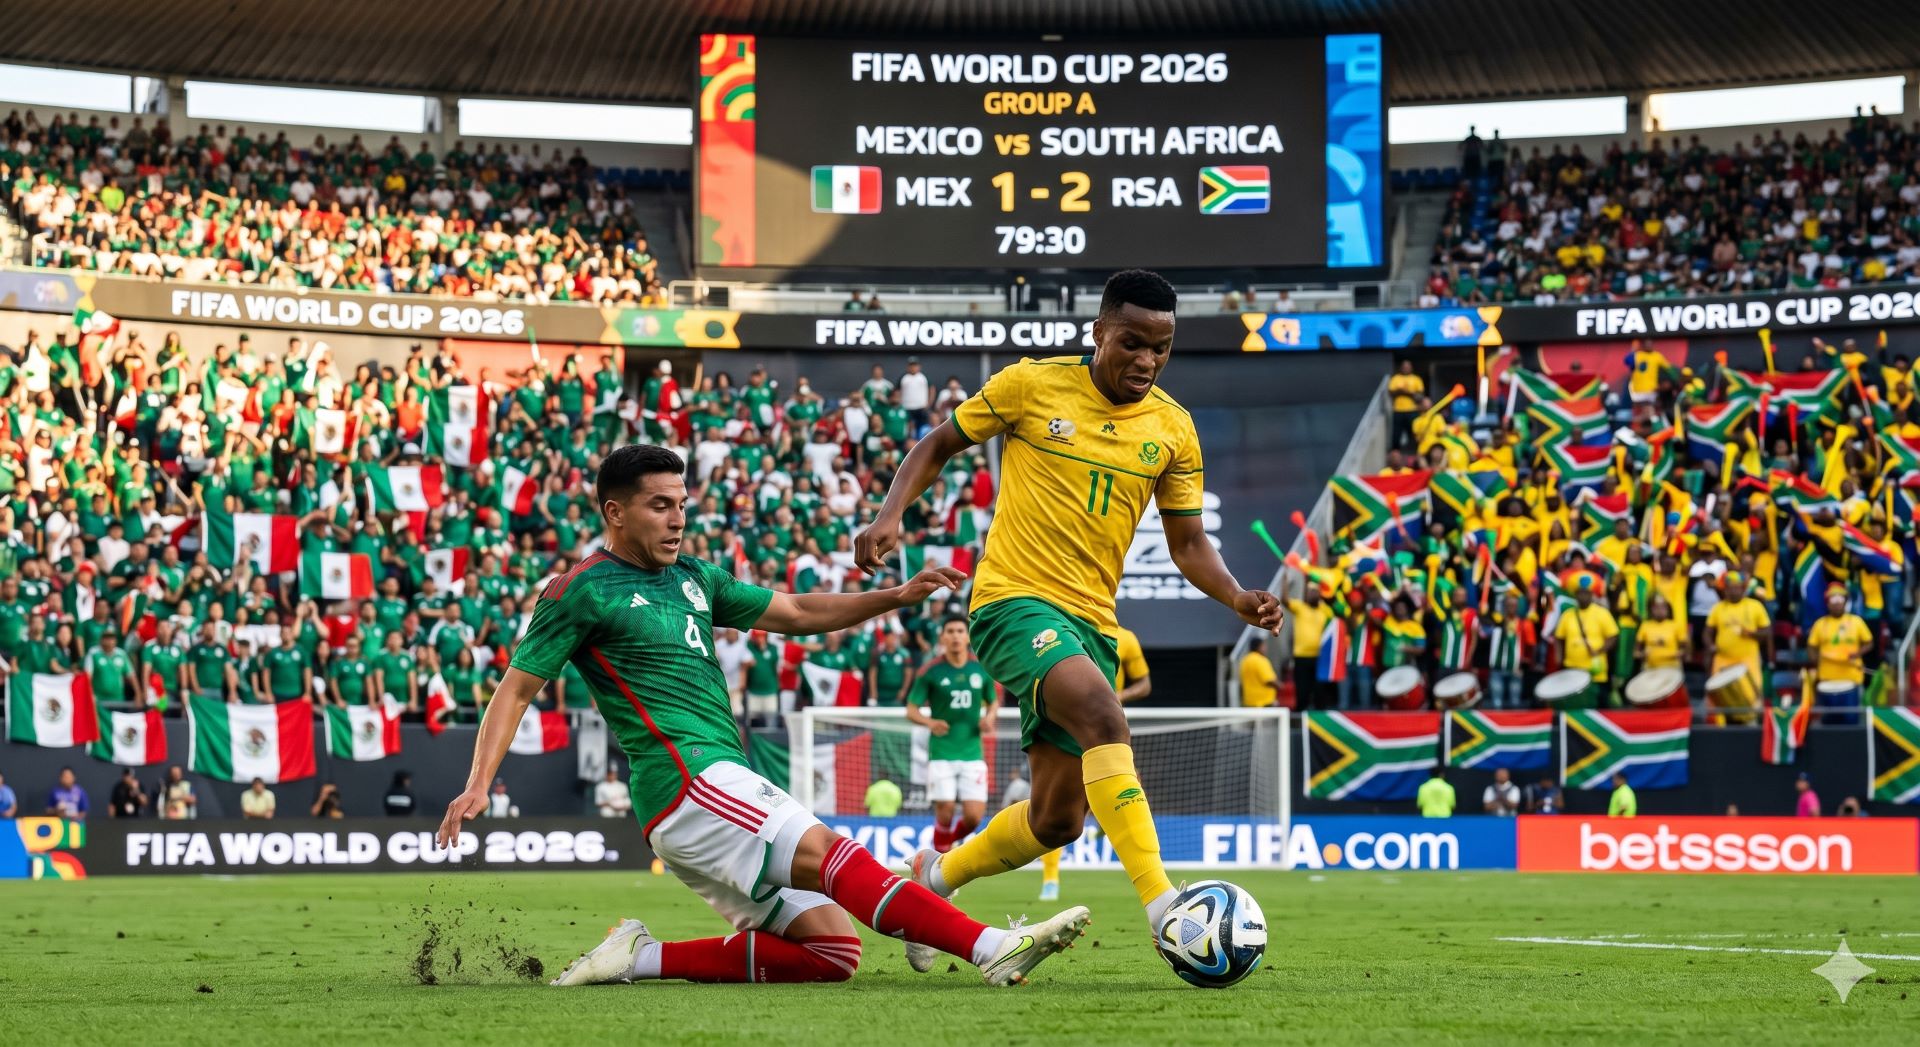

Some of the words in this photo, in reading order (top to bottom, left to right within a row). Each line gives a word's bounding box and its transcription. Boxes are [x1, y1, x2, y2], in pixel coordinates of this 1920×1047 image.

[851, 52, 925, 82] FIFA
[931, 53, 1058, 84] WORLD
[1064, 54, 1134, 84] CUP
[1140, 52, 1229, 83] 2026
[983, 91, 1072, 115] GROUP
[1075, 91, 1097, 115] A
[856, 126, 983, 156] MEXICO
[1040, 127, 1156, 157] SOUTH
[1161, 124, 1284, 155] AFRICA
[896, 176, 973, 207] MEX
[991, 171, 1015, 213] 1
[1060, 171, 1091, 212] 2
[1111, 176, 1183, 208] RSA
[994, 225, 1086, 255] 79:30
[171, 289, 241, 320] FIFA
[245, 295, 357, 326] WORLD
[368, 302, 433, 330] CUP
[440, 307, 525, 335] 2026
[1576, 304, 1648, 336] FIFA
[1651, 299, 1771, 334] WORLD
[1776, 296, 1843, 326] CUP
[815, 319, 886, 346] FIFA
[888, 320, 1007, 347] WORLD
[1010, 321, 1078, 347] CUP
[1087, 469, 1114, 517] 11
[684, 614, 709, 657] 4
[950, 689, 973, 709] 20
[126, 832, 215, 866] FIFA
[219, 832, 380, 866] WORLD
[386, 831, 480, 864] CUP
[1202, 823, 1459, 871] FIFA.com
[1580, 822, 1853, 872] betssson
